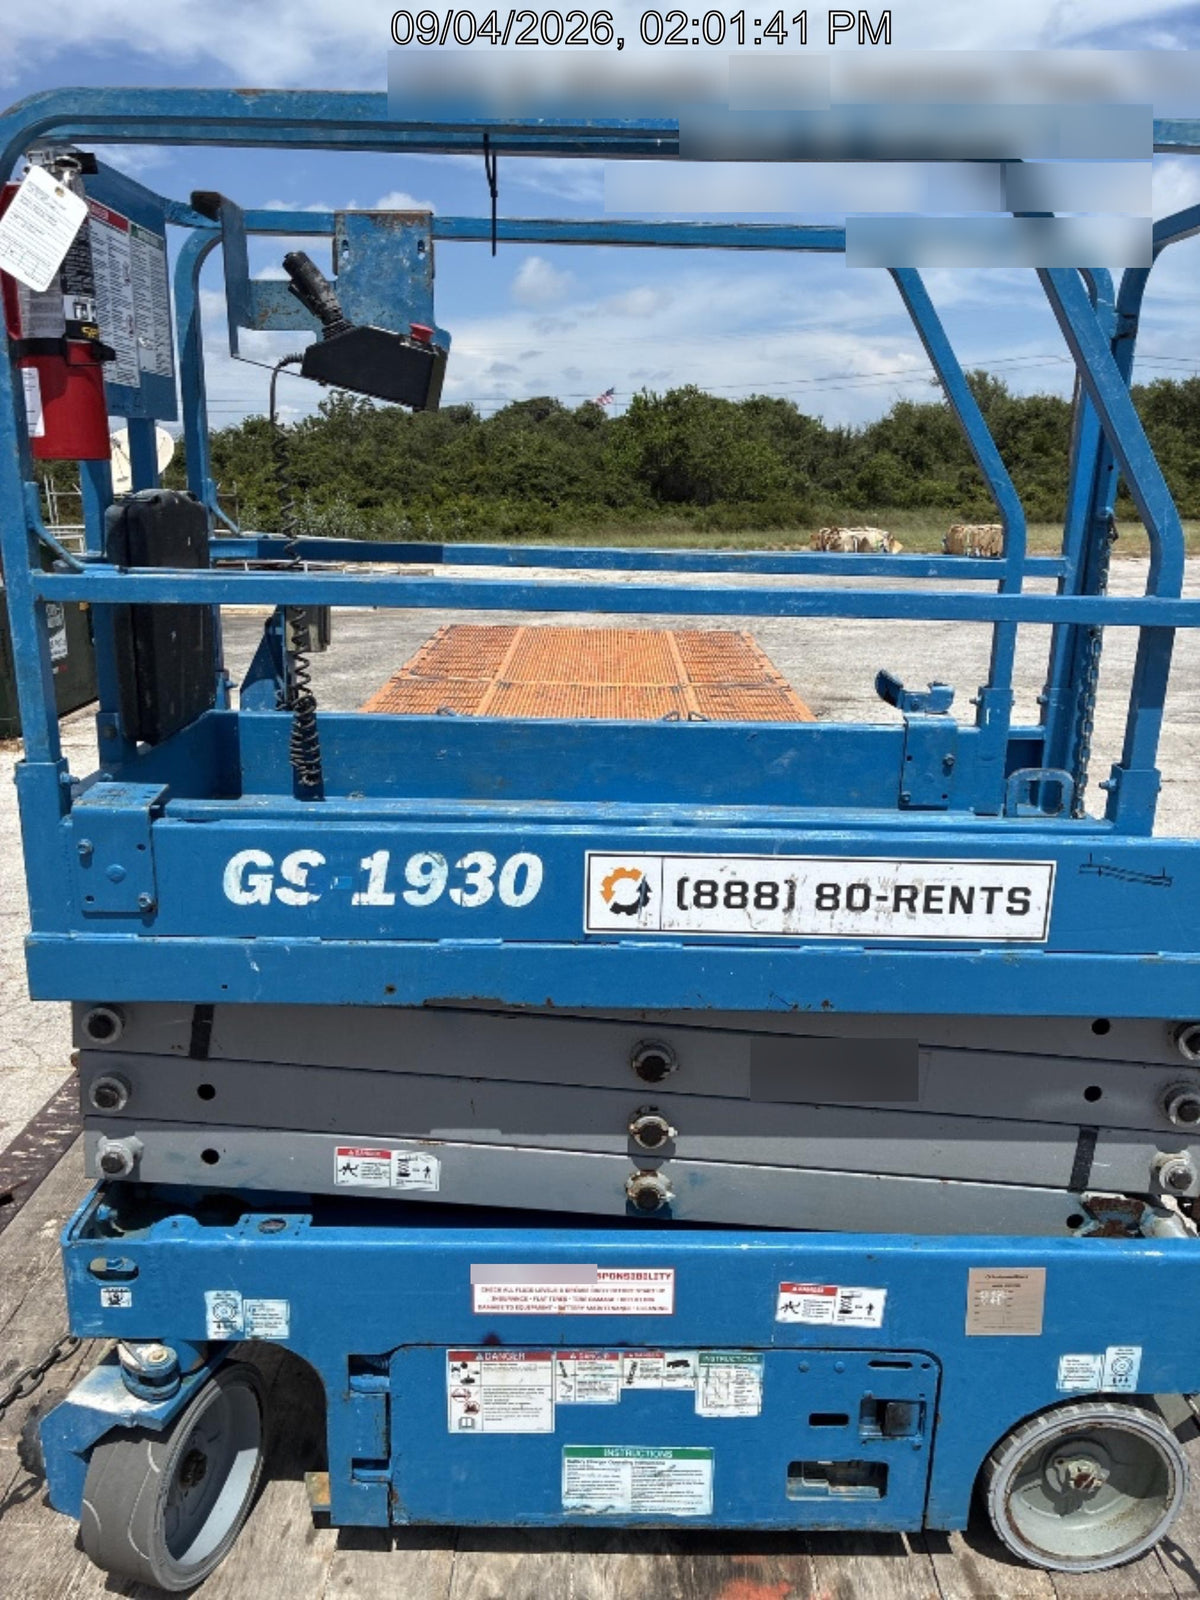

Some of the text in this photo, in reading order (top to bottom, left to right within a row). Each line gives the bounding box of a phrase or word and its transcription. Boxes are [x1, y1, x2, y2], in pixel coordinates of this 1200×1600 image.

[351, 850, 544, 908] 1930
[677, 876, 1032, 917] (888) 80-RENTS
[597, 1272, 672, 1281] SPONSIBILITY
[485, 1352, 525, 1361] DANGER
[603, 1448, 674, 1459] INSTRUCTIONS
